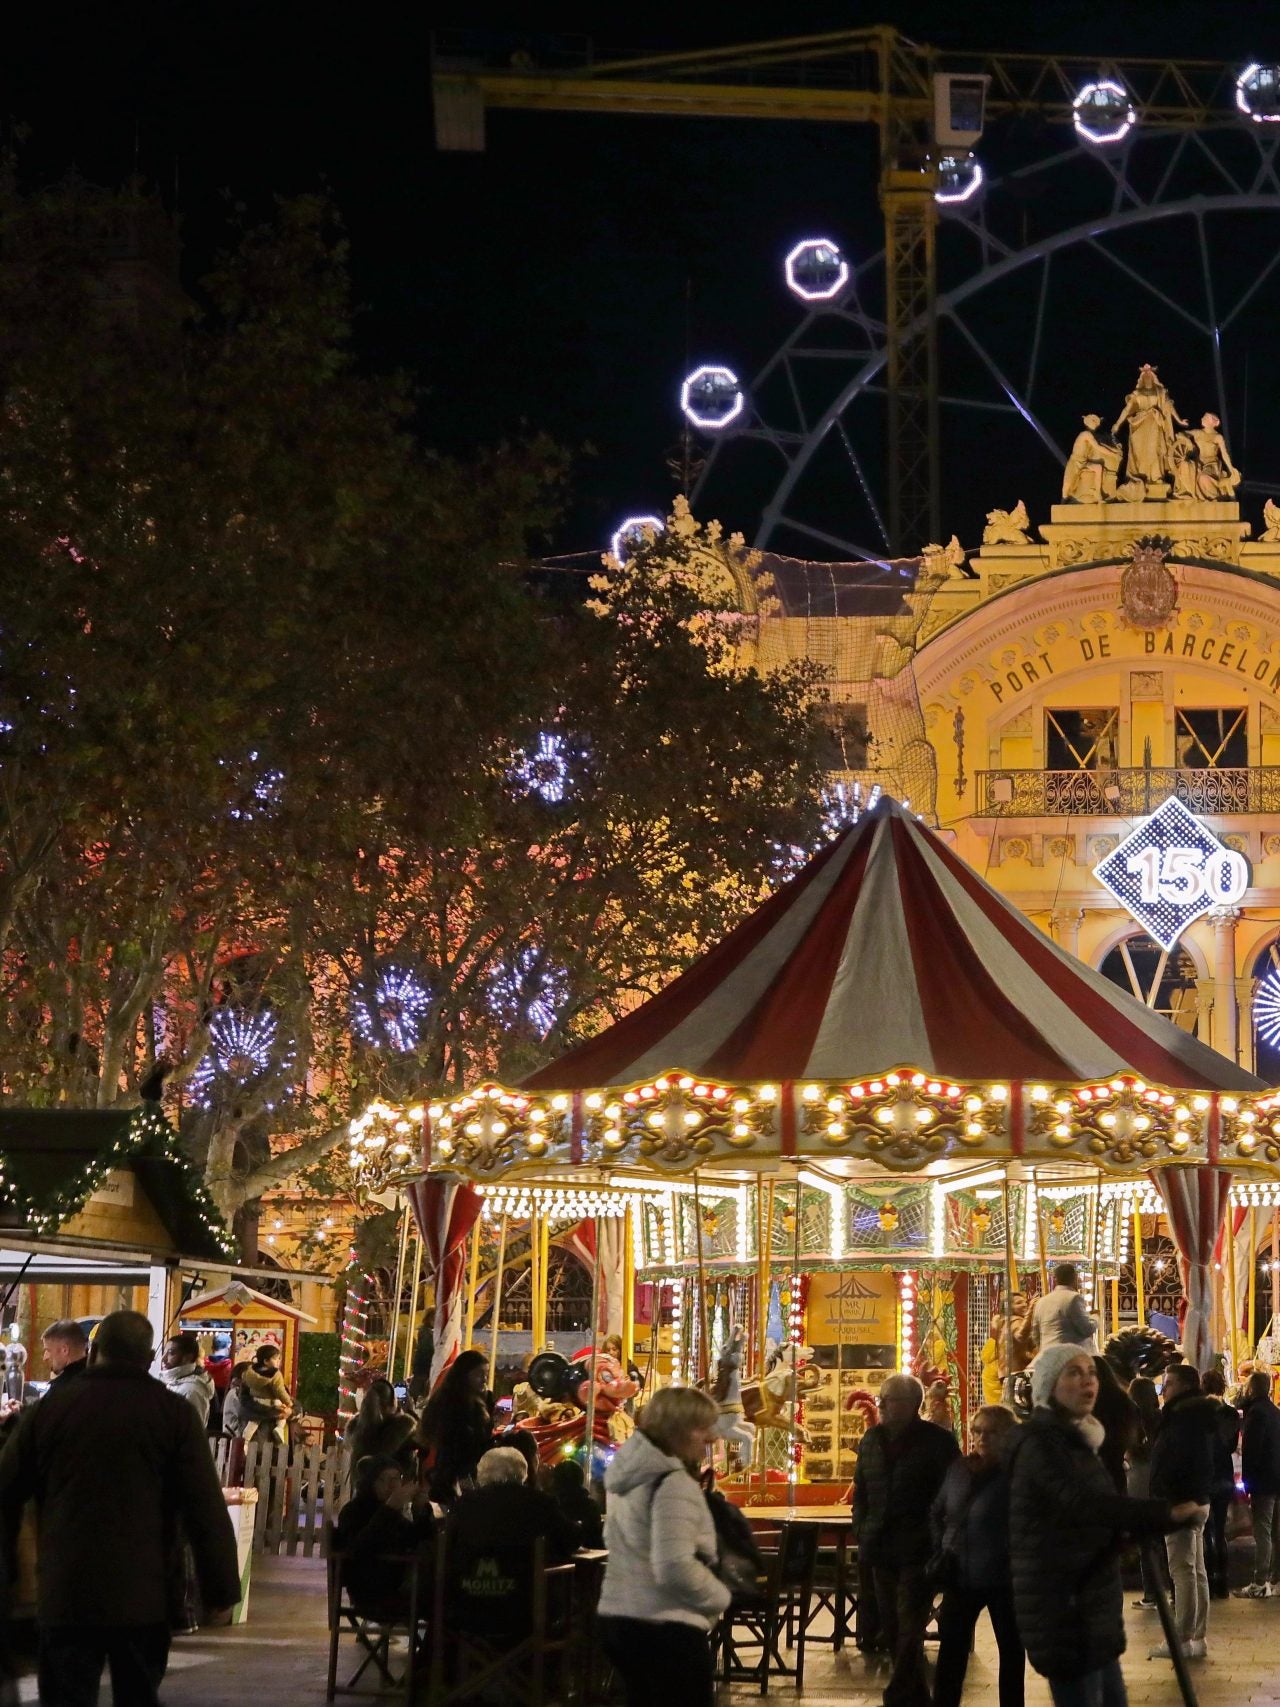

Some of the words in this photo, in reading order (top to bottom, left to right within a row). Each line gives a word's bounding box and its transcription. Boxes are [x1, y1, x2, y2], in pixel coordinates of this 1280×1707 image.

[989, 652, 1054, 703] PORT
[1079, 634, 1112, 661] DE
[1126, 846, 1249, 905] 150
